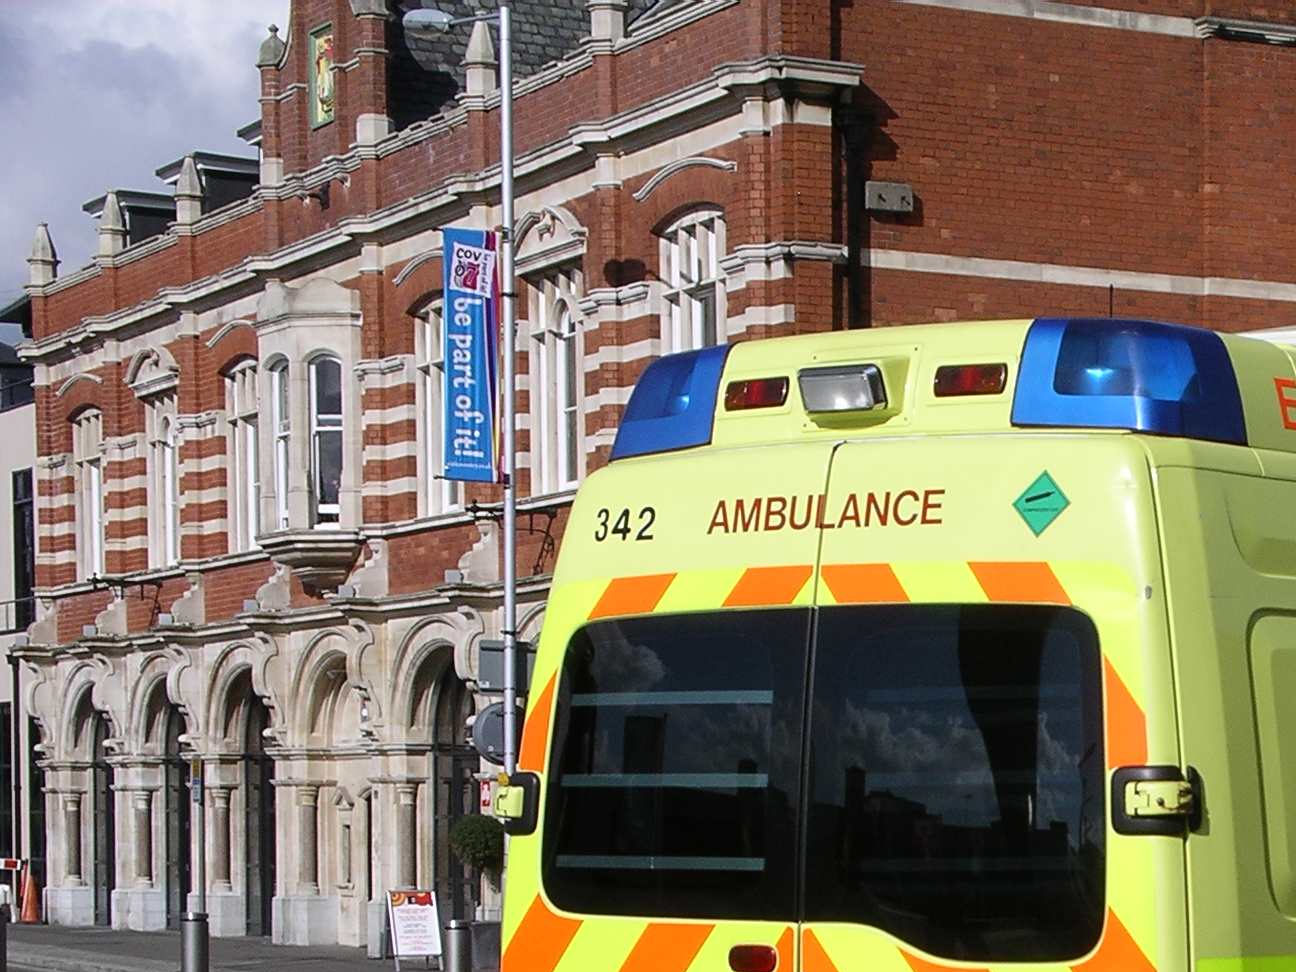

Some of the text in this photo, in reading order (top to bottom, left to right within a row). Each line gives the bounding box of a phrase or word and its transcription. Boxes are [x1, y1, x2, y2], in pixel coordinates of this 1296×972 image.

[453, 296, 483, 327] be
[448, 334, 477, 389] part
[454, 394, 485, 424] of
[453, 427, 485, 458] it!
[594, 488, 946, 542] 342 AMBULANCE
